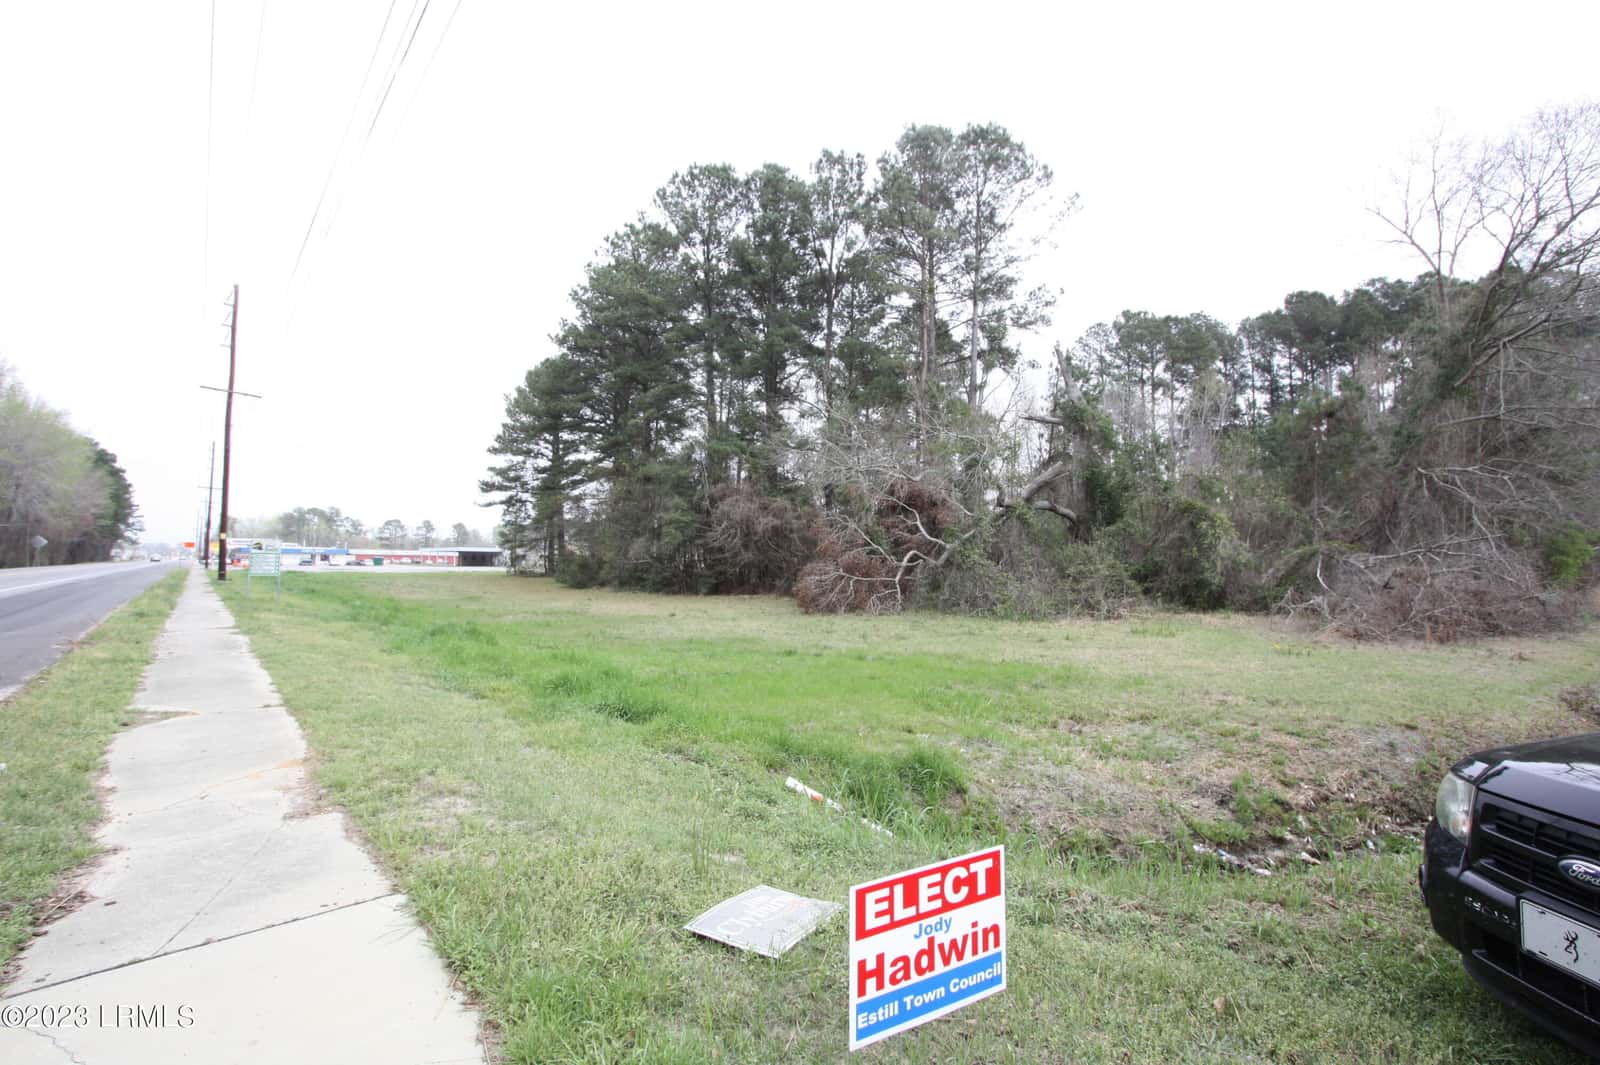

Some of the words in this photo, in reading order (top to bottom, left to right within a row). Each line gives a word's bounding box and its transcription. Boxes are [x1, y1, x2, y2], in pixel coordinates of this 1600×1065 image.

[865, 859, 993, 930] ELECT
[914, 917, 952, 939] Jody
[857, 921, 1000, 998] Hadwin
[858, 1002, 898, 1029] Estill
[904, 986, 944, 1011] Town
[950, 962, 1001, 994] Council
